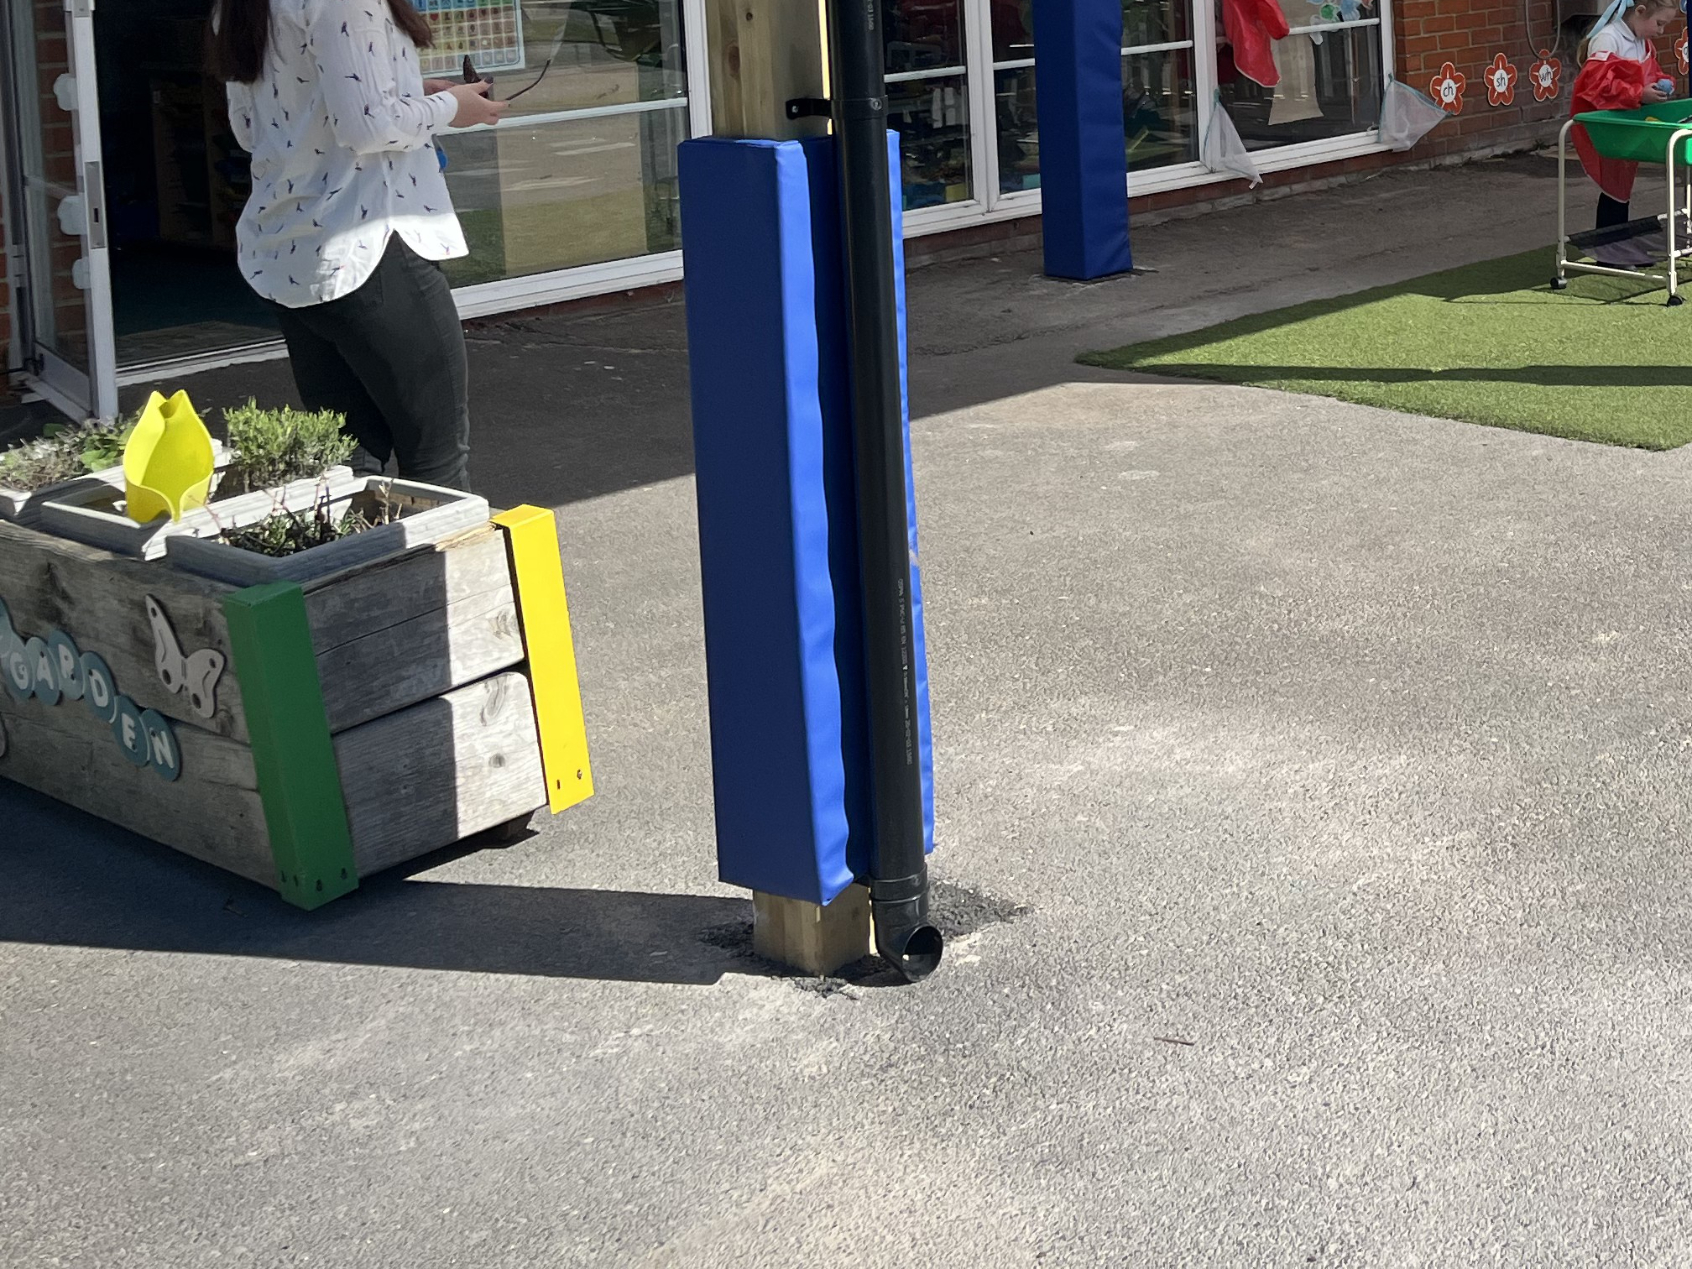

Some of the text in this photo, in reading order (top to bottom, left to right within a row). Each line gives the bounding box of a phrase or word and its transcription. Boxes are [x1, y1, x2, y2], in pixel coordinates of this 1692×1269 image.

[1443, 67, 1553, 98] ch sh wh
[9, 642, 176, 770] GARDEN
